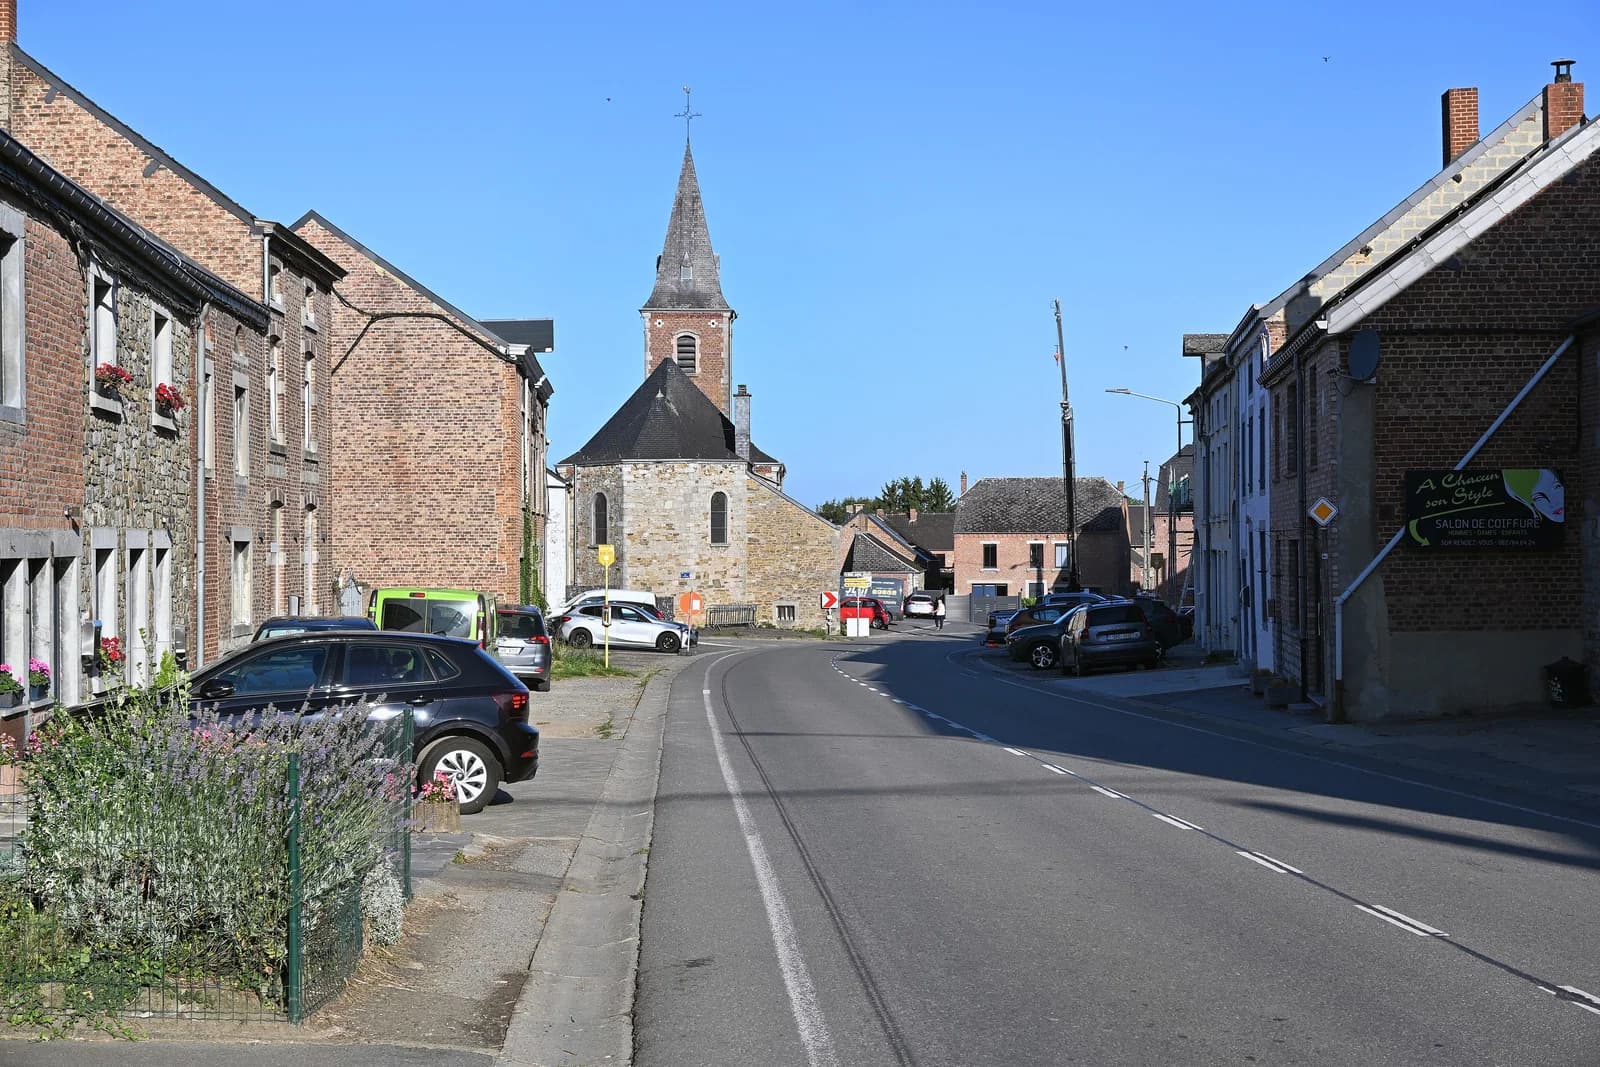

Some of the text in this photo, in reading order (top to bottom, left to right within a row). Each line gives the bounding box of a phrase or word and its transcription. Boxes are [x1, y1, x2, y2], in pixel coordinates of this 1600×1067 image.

[1416, 473, 1500, 494] A Chacun
[1425, 486, 1495, 509] son Style
[1435, 519, 1540, 529] SALON DE COIFFURE
